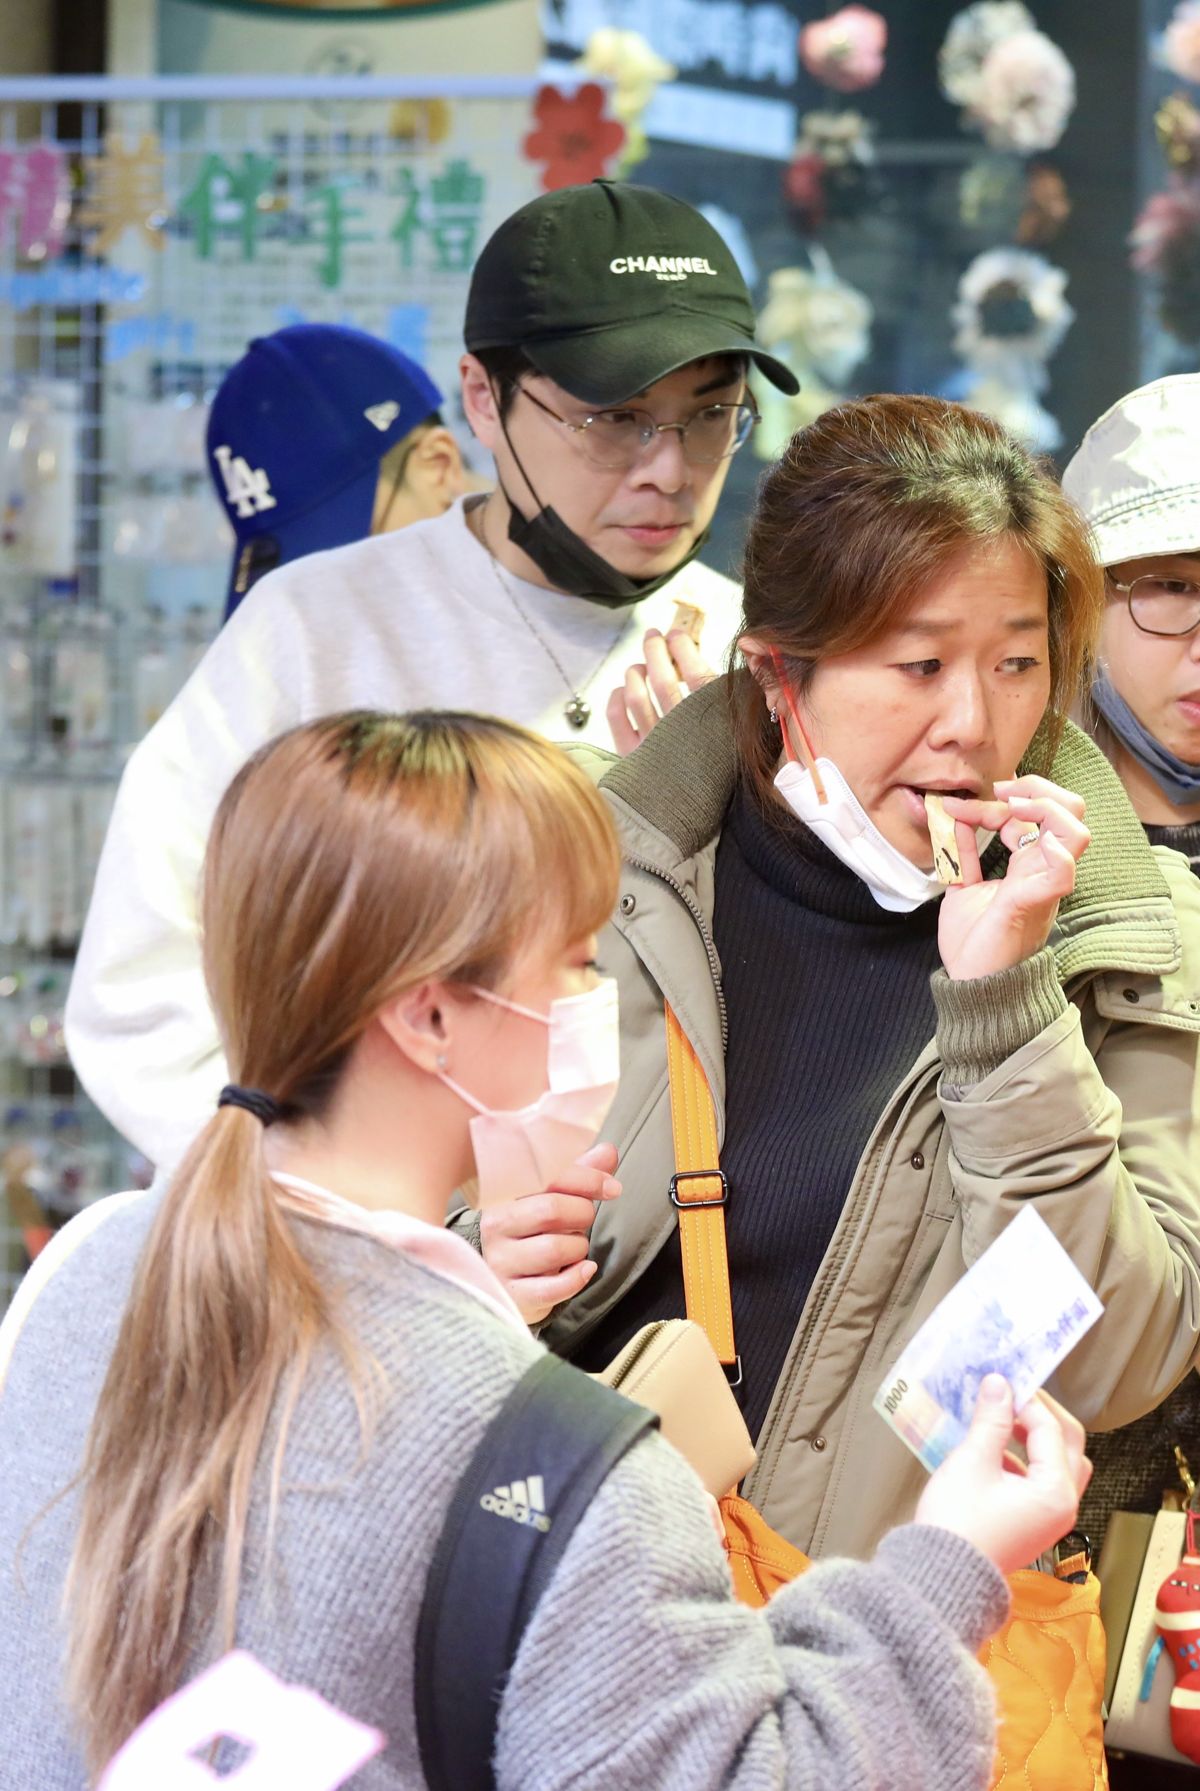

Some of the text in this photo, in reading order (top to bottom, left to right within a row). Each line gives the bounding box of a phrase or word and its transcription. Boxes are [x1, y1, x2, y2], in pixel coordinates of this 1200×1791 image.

[609, 255, 718, 276] CHANNEL
[213, 445, 277, 519] LA
[884, 1379, 908, 1415] 1000
[480, 1493, 551, 1533] adidas
